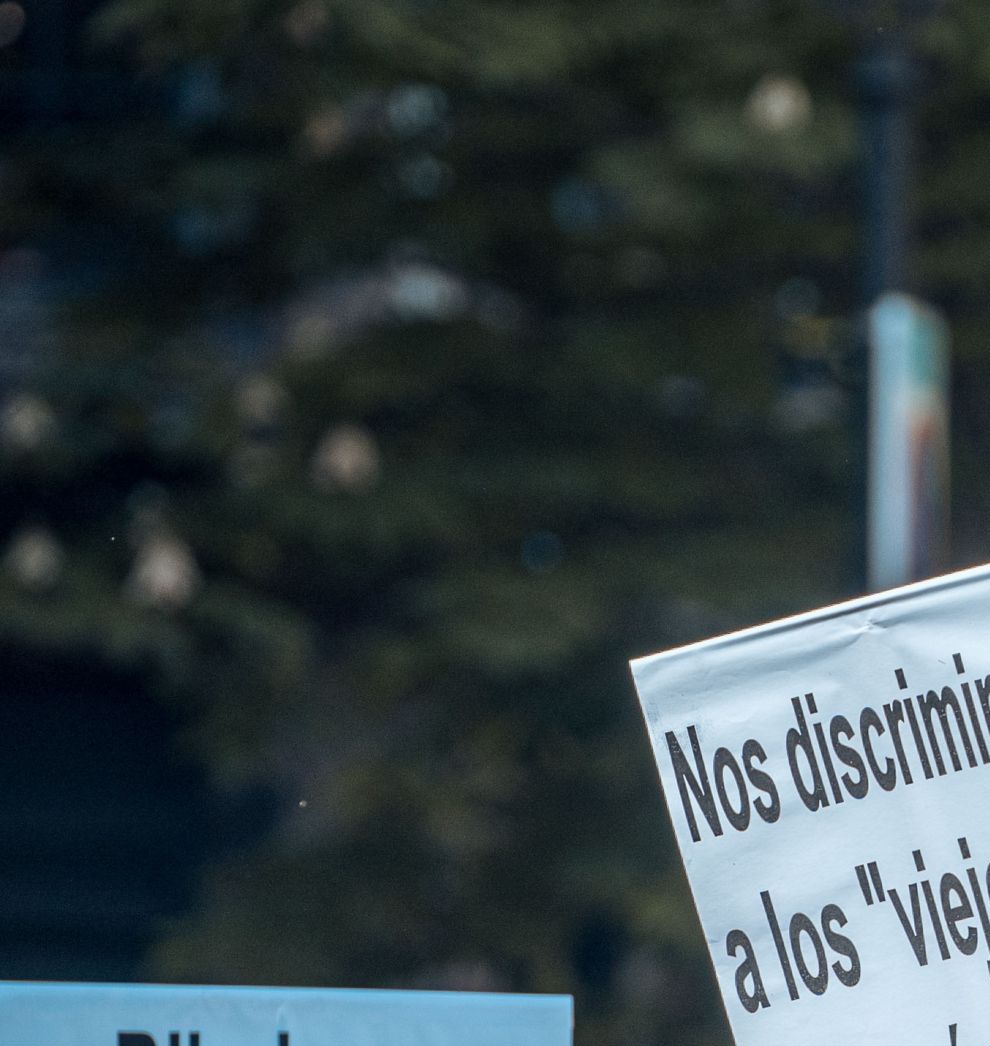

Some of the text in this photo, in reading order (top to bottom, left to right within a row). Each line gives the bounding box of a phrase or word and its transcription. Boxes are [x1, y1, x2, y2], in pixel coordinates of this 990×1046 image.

[664, 724, 781, 843] Nos
[726, 928, 771, 1014] a
[759, 890, 862, 1001] los
